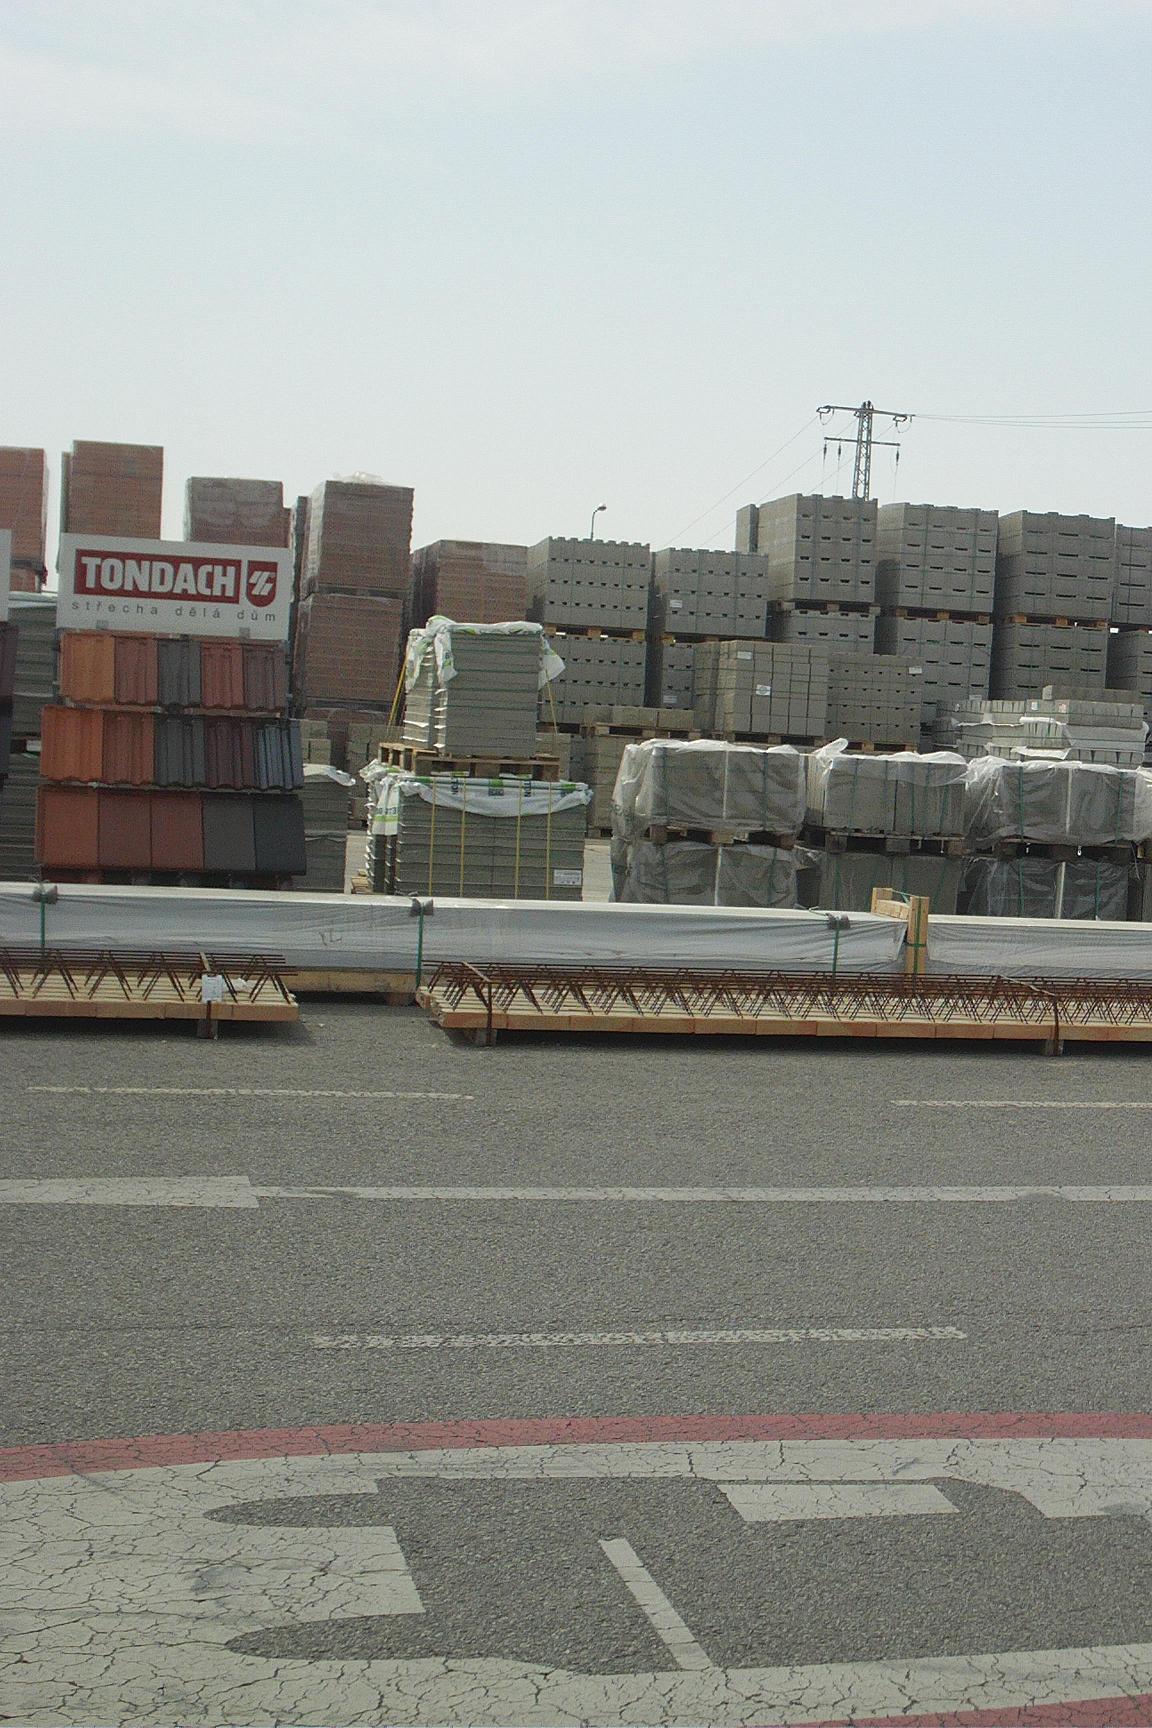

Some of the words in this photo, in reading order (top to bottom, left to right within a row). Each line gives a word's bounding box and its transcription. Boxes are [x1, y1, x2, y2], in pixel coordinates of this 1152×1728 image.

[81, 557, 237, 597] TONDACH
[71, 600, 158, 615] střecha
[236, 605, 277, 622] dům
